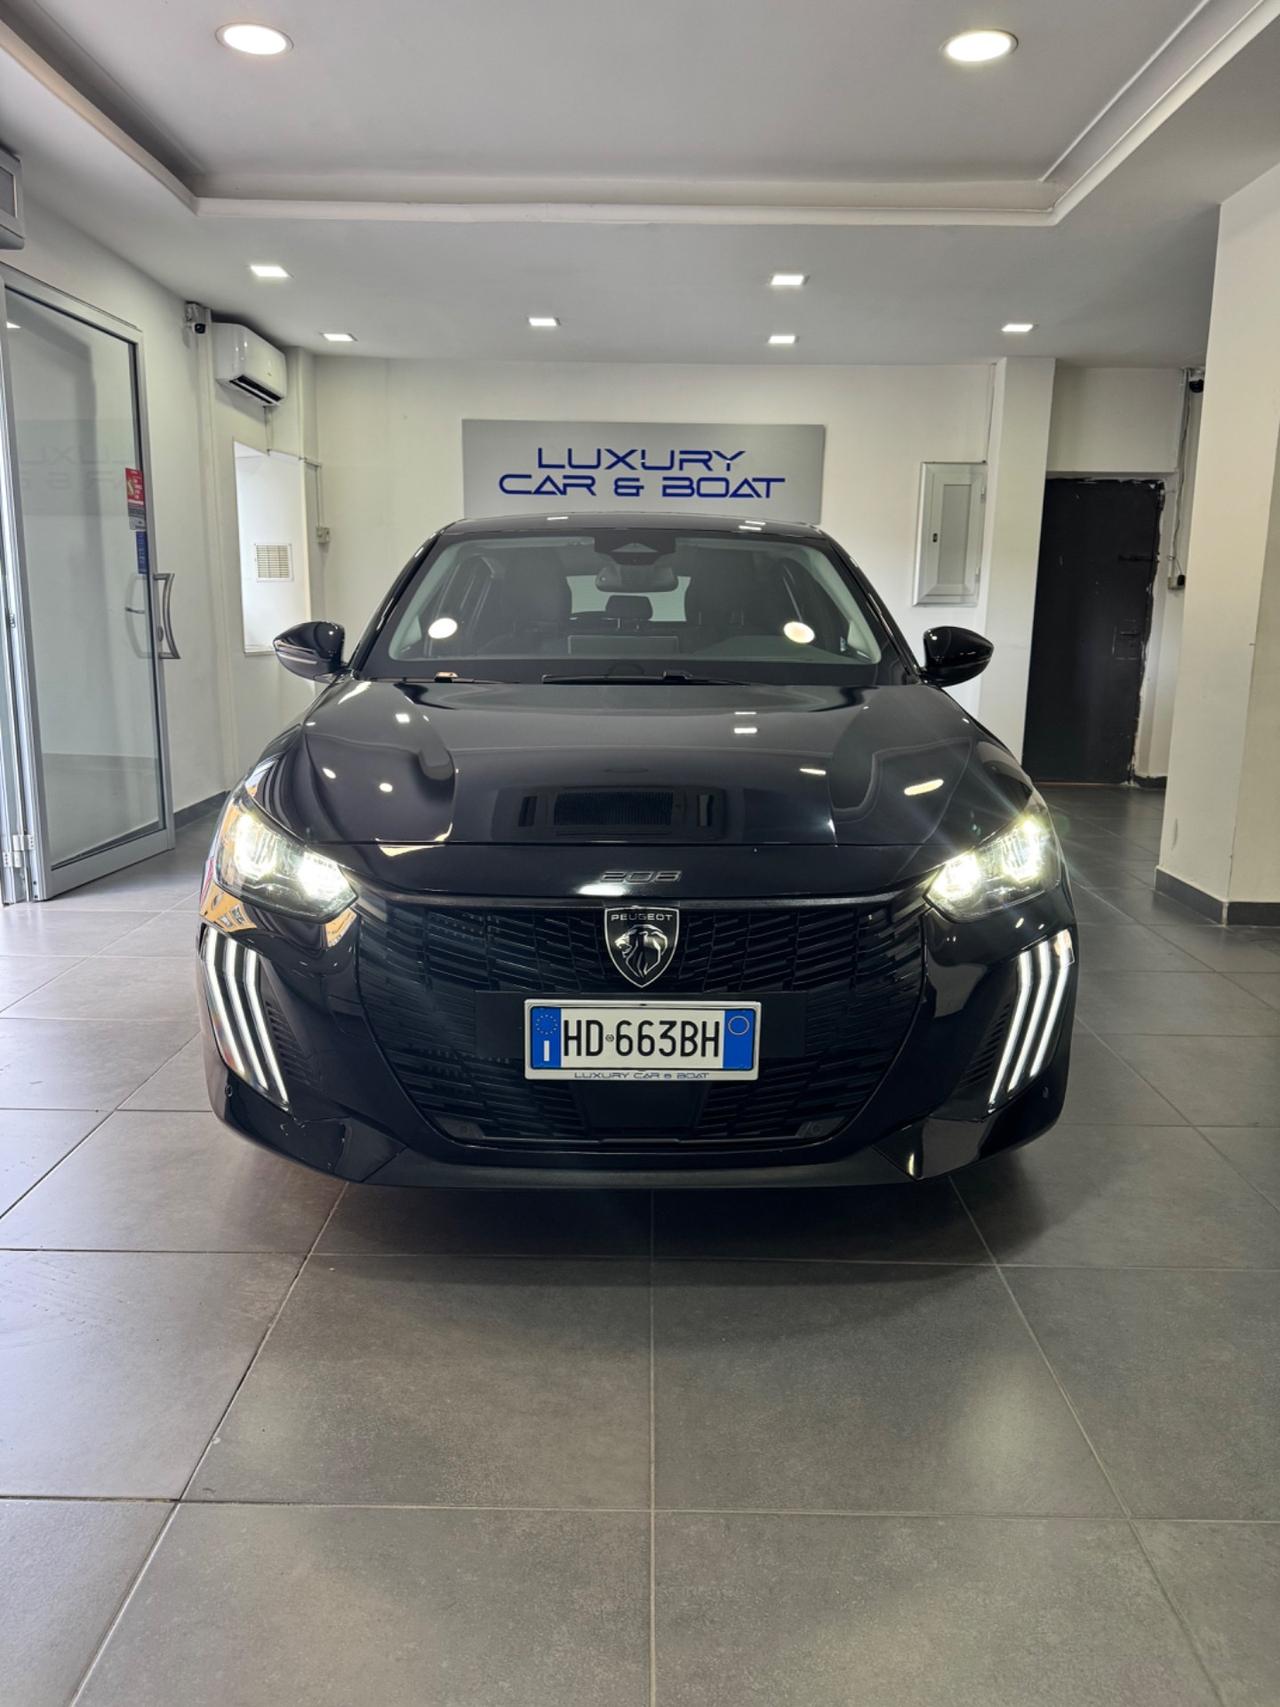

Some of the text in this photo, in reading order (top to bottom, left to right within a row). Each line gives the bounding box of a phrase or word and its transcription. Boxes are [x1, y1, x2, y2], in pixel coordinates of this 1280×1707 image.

[537, 447, 746, 472] LUXURY
[499, 474, 786, 499] CAR & BOAT
[601, 869, 682, 885] 208
[610, 912, 673, 921] PEUGEOT
[633, 1072, 660, 1080] CAR
[676, 1072, 710, 1080] BOAT
